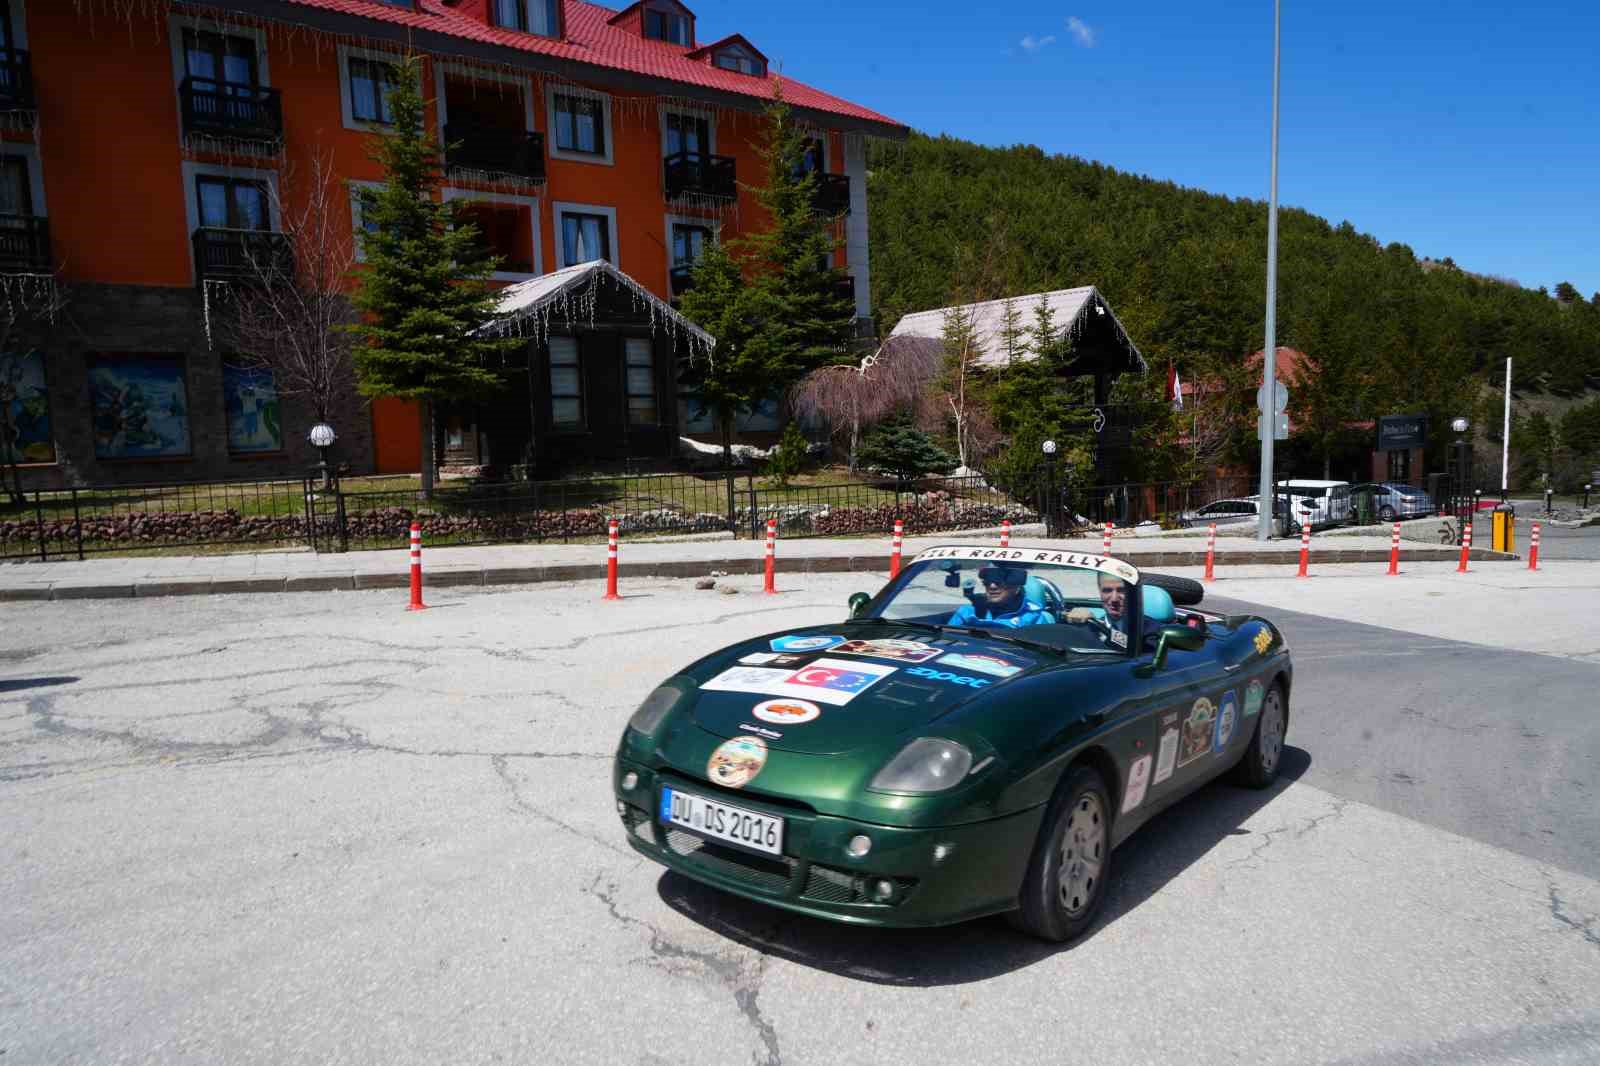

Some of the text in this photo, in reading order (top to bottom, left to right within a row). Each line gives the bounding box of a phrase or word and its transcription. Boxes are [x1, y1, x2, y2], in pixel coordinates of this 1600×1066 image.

[969, 549, 1023, 560] ROAD
[1034, 552, 1107, 568] RALLY
[672, 795, 776, 848] DU DS 2016
